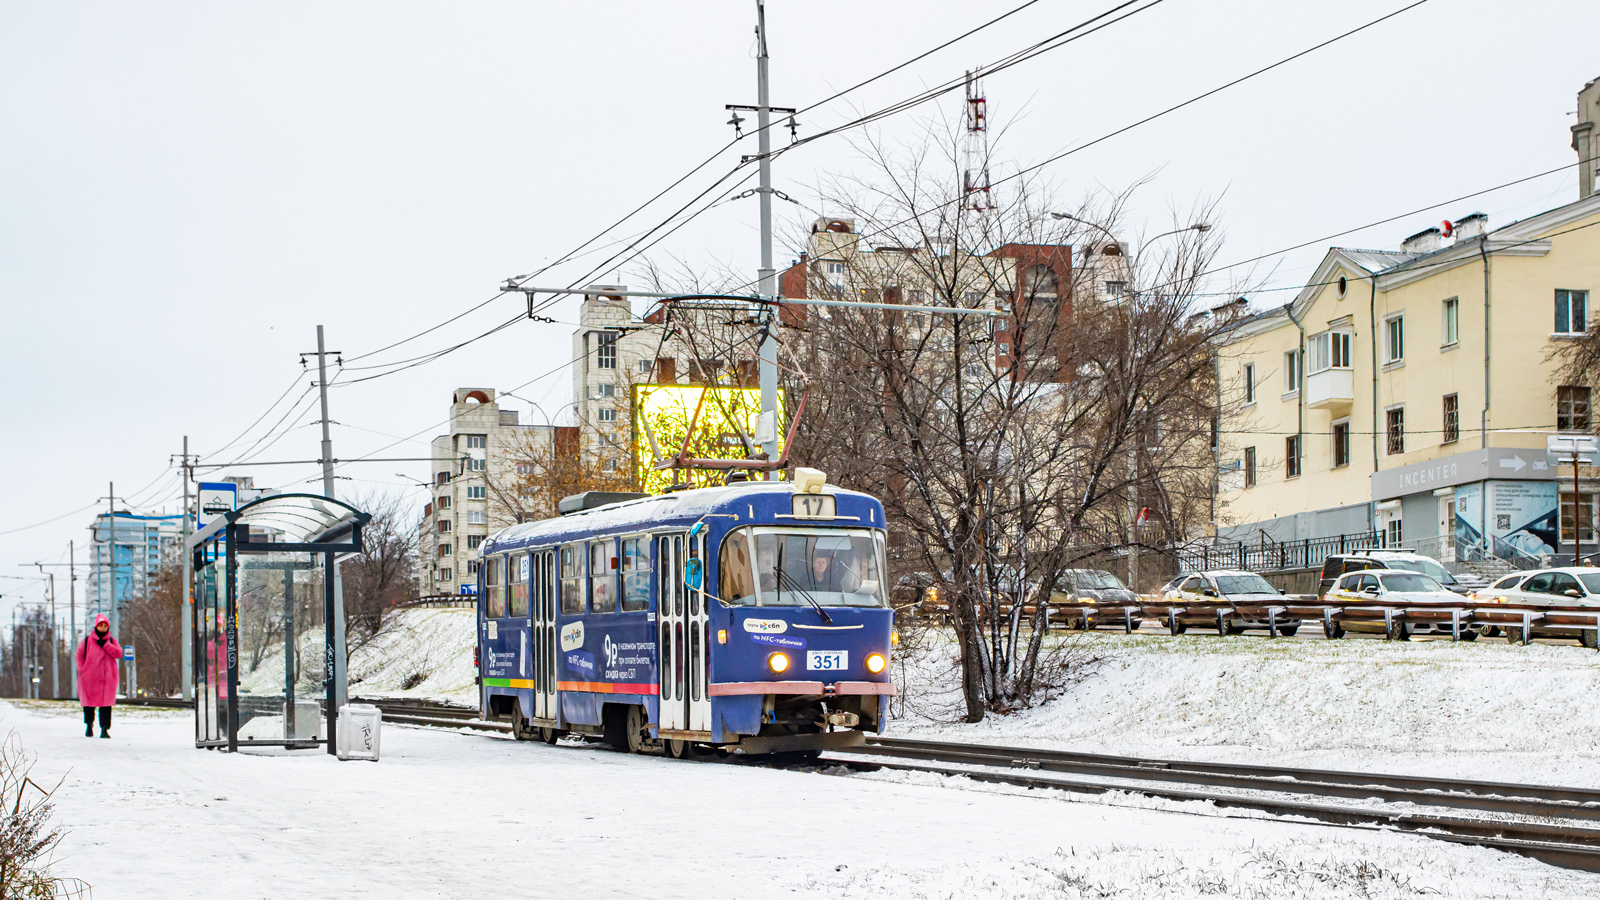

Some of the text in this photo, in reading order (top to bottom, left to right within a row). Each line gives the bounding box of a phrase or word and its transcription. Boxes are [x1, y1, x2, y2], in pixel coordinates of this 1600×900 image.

[1399, 462, 1457, 488] INCENTER
[802, 498, 824, 518] 17
[761, 635, 803, 647] NFC-табличке
[813, 655, 840, 669] 351
